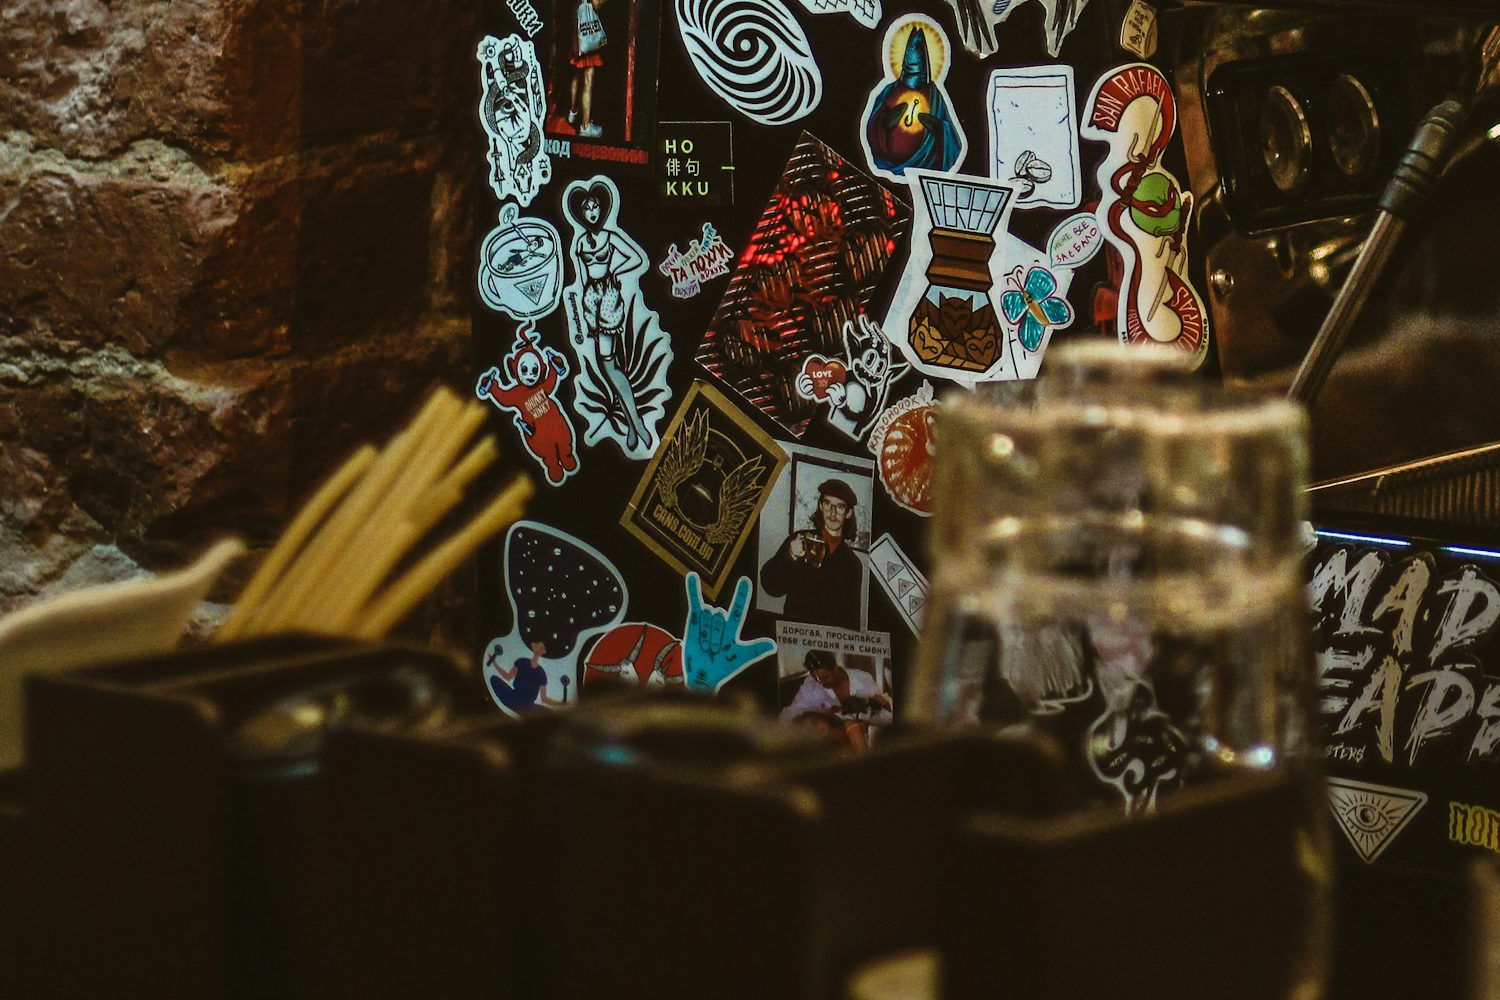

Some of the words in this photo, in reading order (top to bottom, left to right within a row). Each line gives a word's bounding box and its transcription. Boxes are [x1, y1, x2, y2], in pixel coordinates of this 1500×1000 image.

[1093, 96, 1118, 127] SAN
[1112, 69, 1165, 101] RAFAEL
[665, 140, 695, 154] HO
[665, 158, 701, 177] 俳句
[666, 181, 709, 197] KKU
[670, 267, 688, 284] ТА
[812, 370, 833, 379] LOVE
